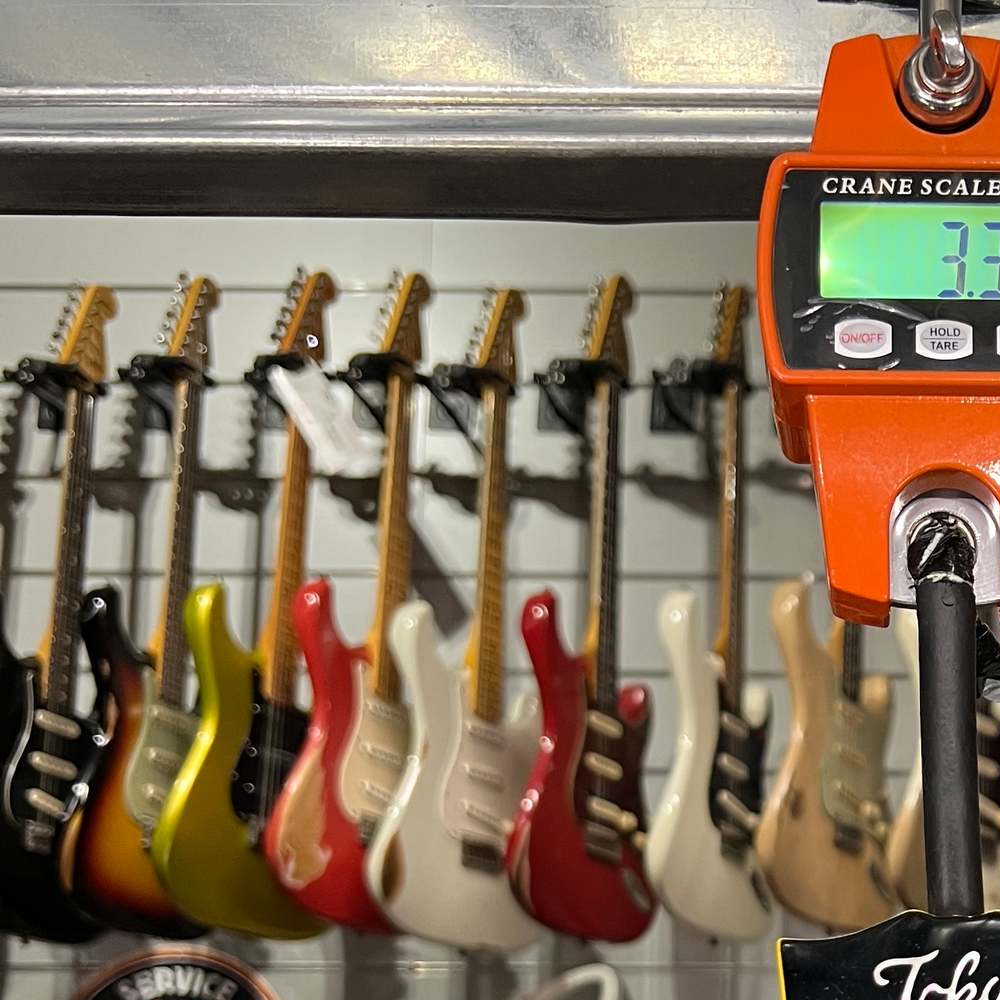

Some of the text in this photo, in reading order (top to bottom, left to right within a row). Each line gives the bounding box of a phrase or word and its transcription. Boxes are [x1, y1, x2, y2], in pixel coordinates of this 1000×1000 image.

[821, 177, 913, 196] CRANE
[929, 326, 961, 338] HOLD
[841, 332, 884, 345] ON/OFF
[930, 340, 959, 351] TARE
